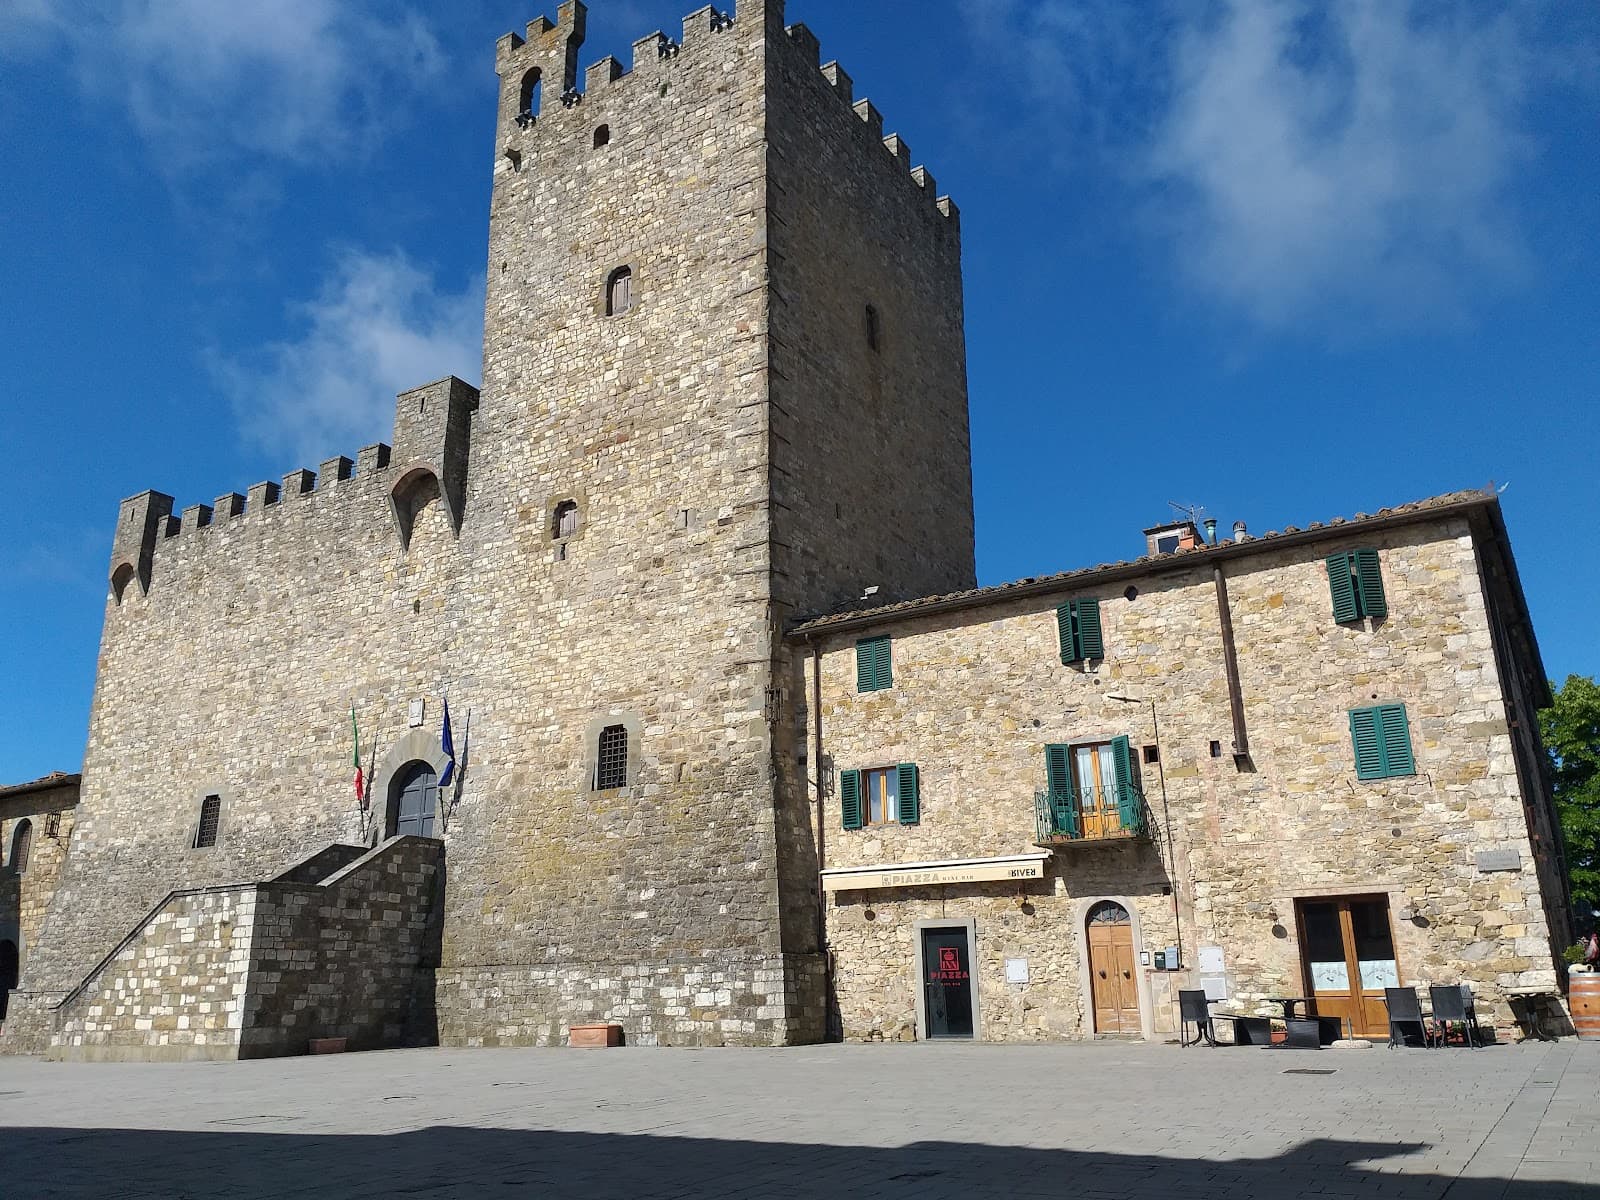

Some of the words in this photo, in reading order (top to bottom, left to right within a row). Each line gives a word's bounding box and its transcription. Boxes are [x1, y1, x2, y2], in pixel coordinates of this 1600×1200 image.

[892, 873, 940, 885] PIAZZA
[942, 960, 957, 969] INN
[930, 971, 969, 979] PIAZZA
